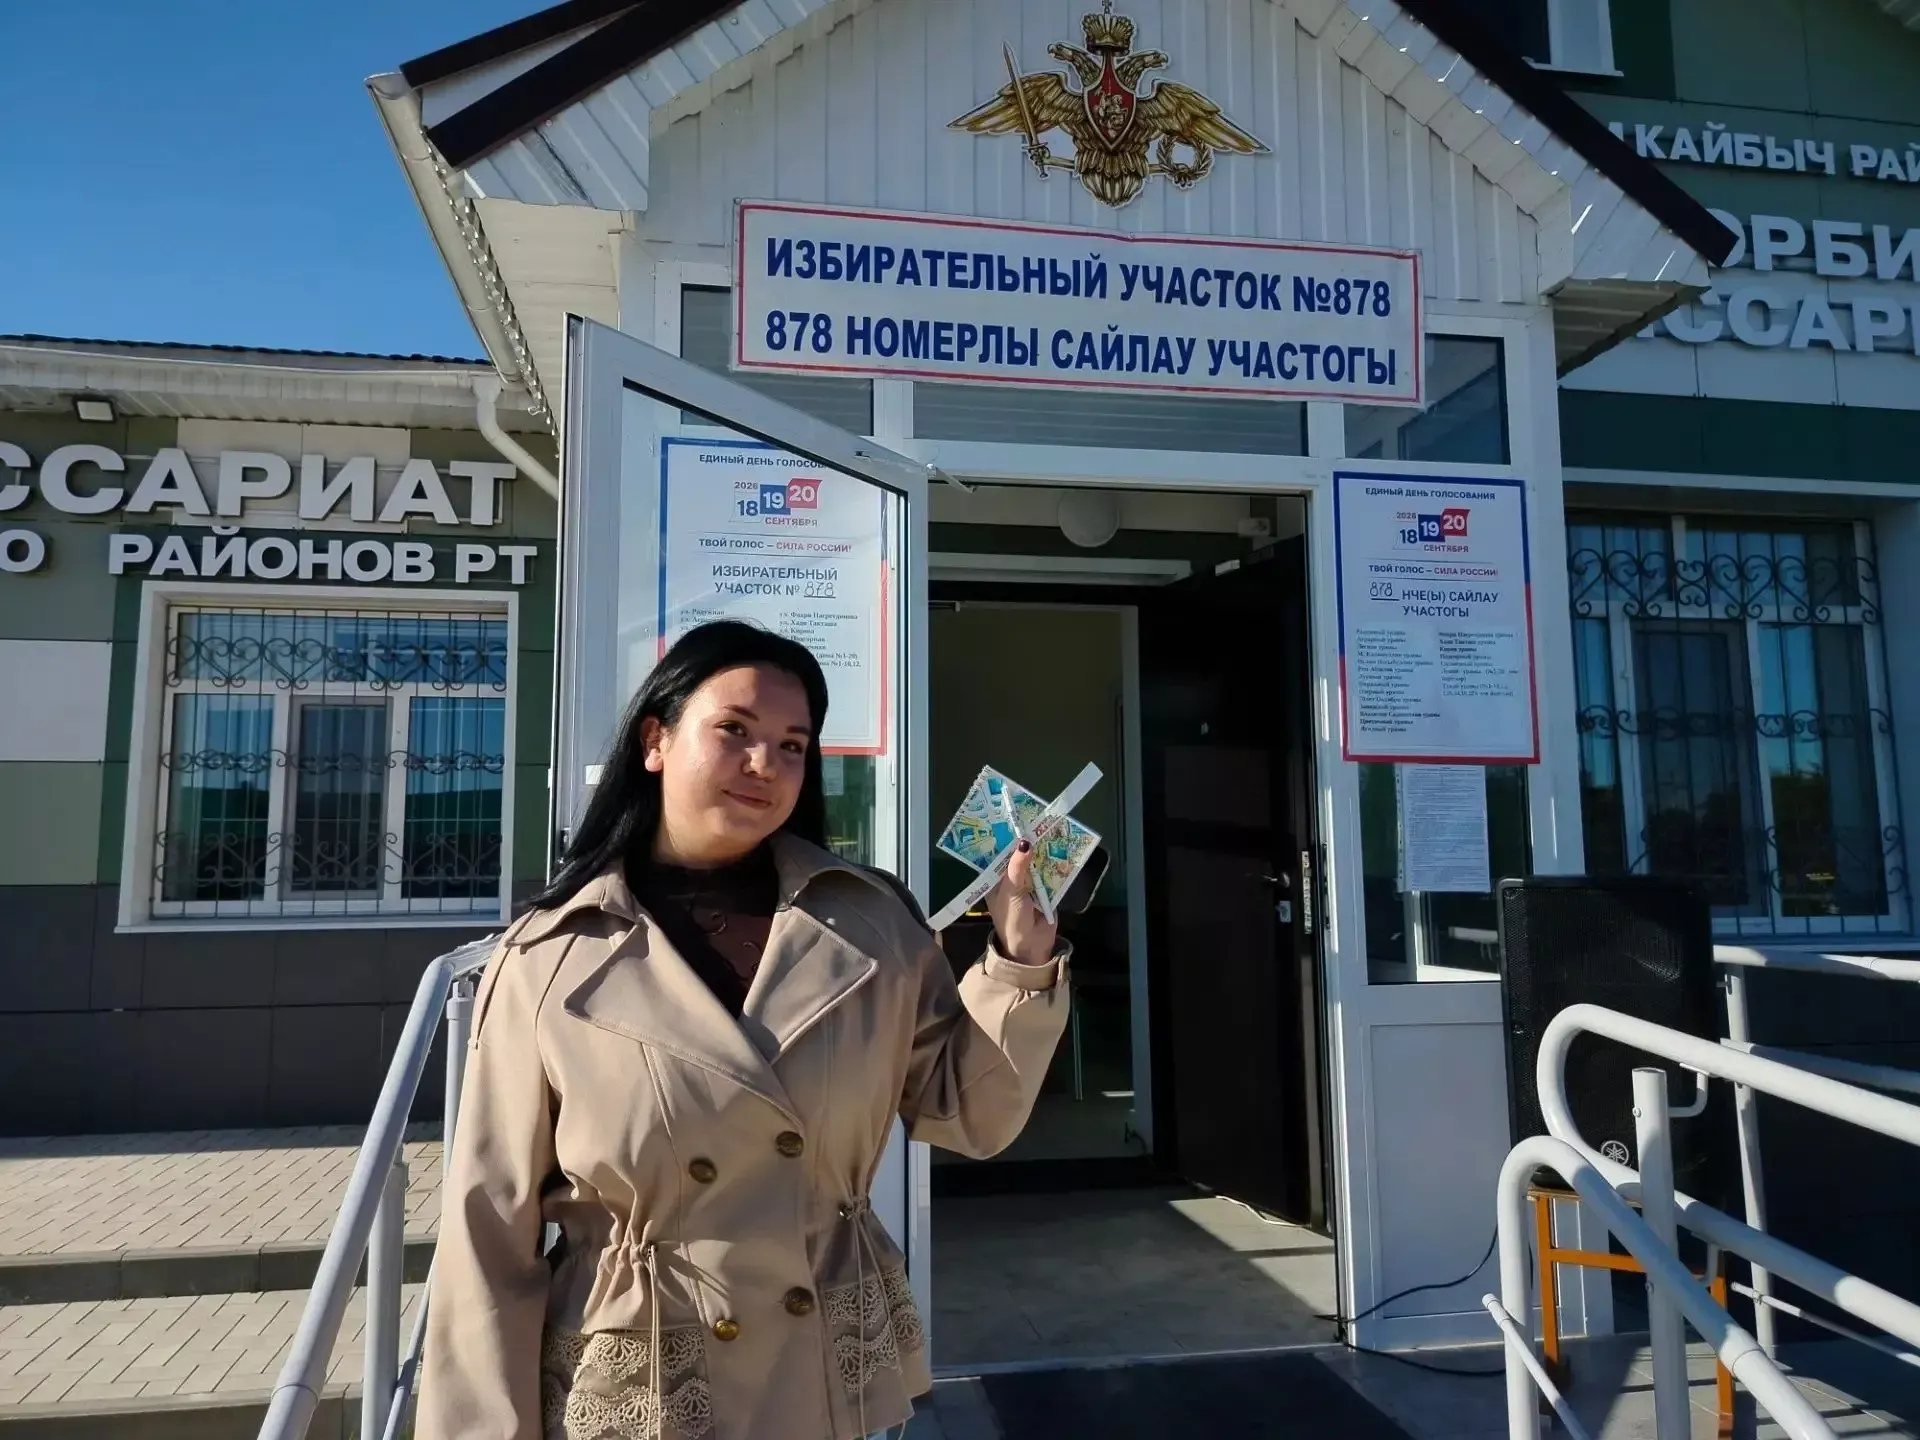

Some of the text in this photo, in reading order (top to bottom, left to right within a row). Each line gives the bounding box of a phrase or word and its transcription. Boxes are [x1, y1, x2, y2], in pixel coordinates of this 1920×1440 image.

[1635, 121, 1836, 175] КАЙБЫЧ
[767, 237, 1391, 317] ИЗБИРАТЕЛЬНЫЙ УЧАСТОК №878
[766, 310, 1396, 385] 878 НОМЕРЛЫ САЙЛАУ УЧАСТОГЫ
[699, 454, 744, 464] ЕДИНЫЙ
[746, 457, 774, 467] ДЕНЬ
[737, 485, 816, 516] 18 19 20
[1365, 487, 1496, 500] ЕДИНЫЙ ДЕНЬ ГОЛОСОВАНИЯ
[765, 516, 819, 527] СЕНТЯБРЯ
[1400, 515, 1465, 544] 18 19 20
[699, 537, 728, 548] ТВОЙ
[729, 540, 765, 549] ГОЛОС
[776, 542, 806, 550] СИЛА
[1423, 544, 1469, 553] СЕНТЯБРЯ
[108, 525, 435, 582] РАЙОНОВ
[455, 543, 538, 585] РТ
[712, 565, 838, 581] ИЗБИРАТЕЛЬНЫЙ
[1369, 564, 1393, 573] ТВОЙ
[1394, 565, 1424, 574] ГОЛОС
[1434, 567, 1458, 576] СИЛА
[714, 581, 835, 598] УЧАСТОК № 878
[1370, 581, 1499, 604] 878 НЧЕ(Ы) САЙЛАУ
[1402, 605, 1469, 618] УЧАСТОГЫ
